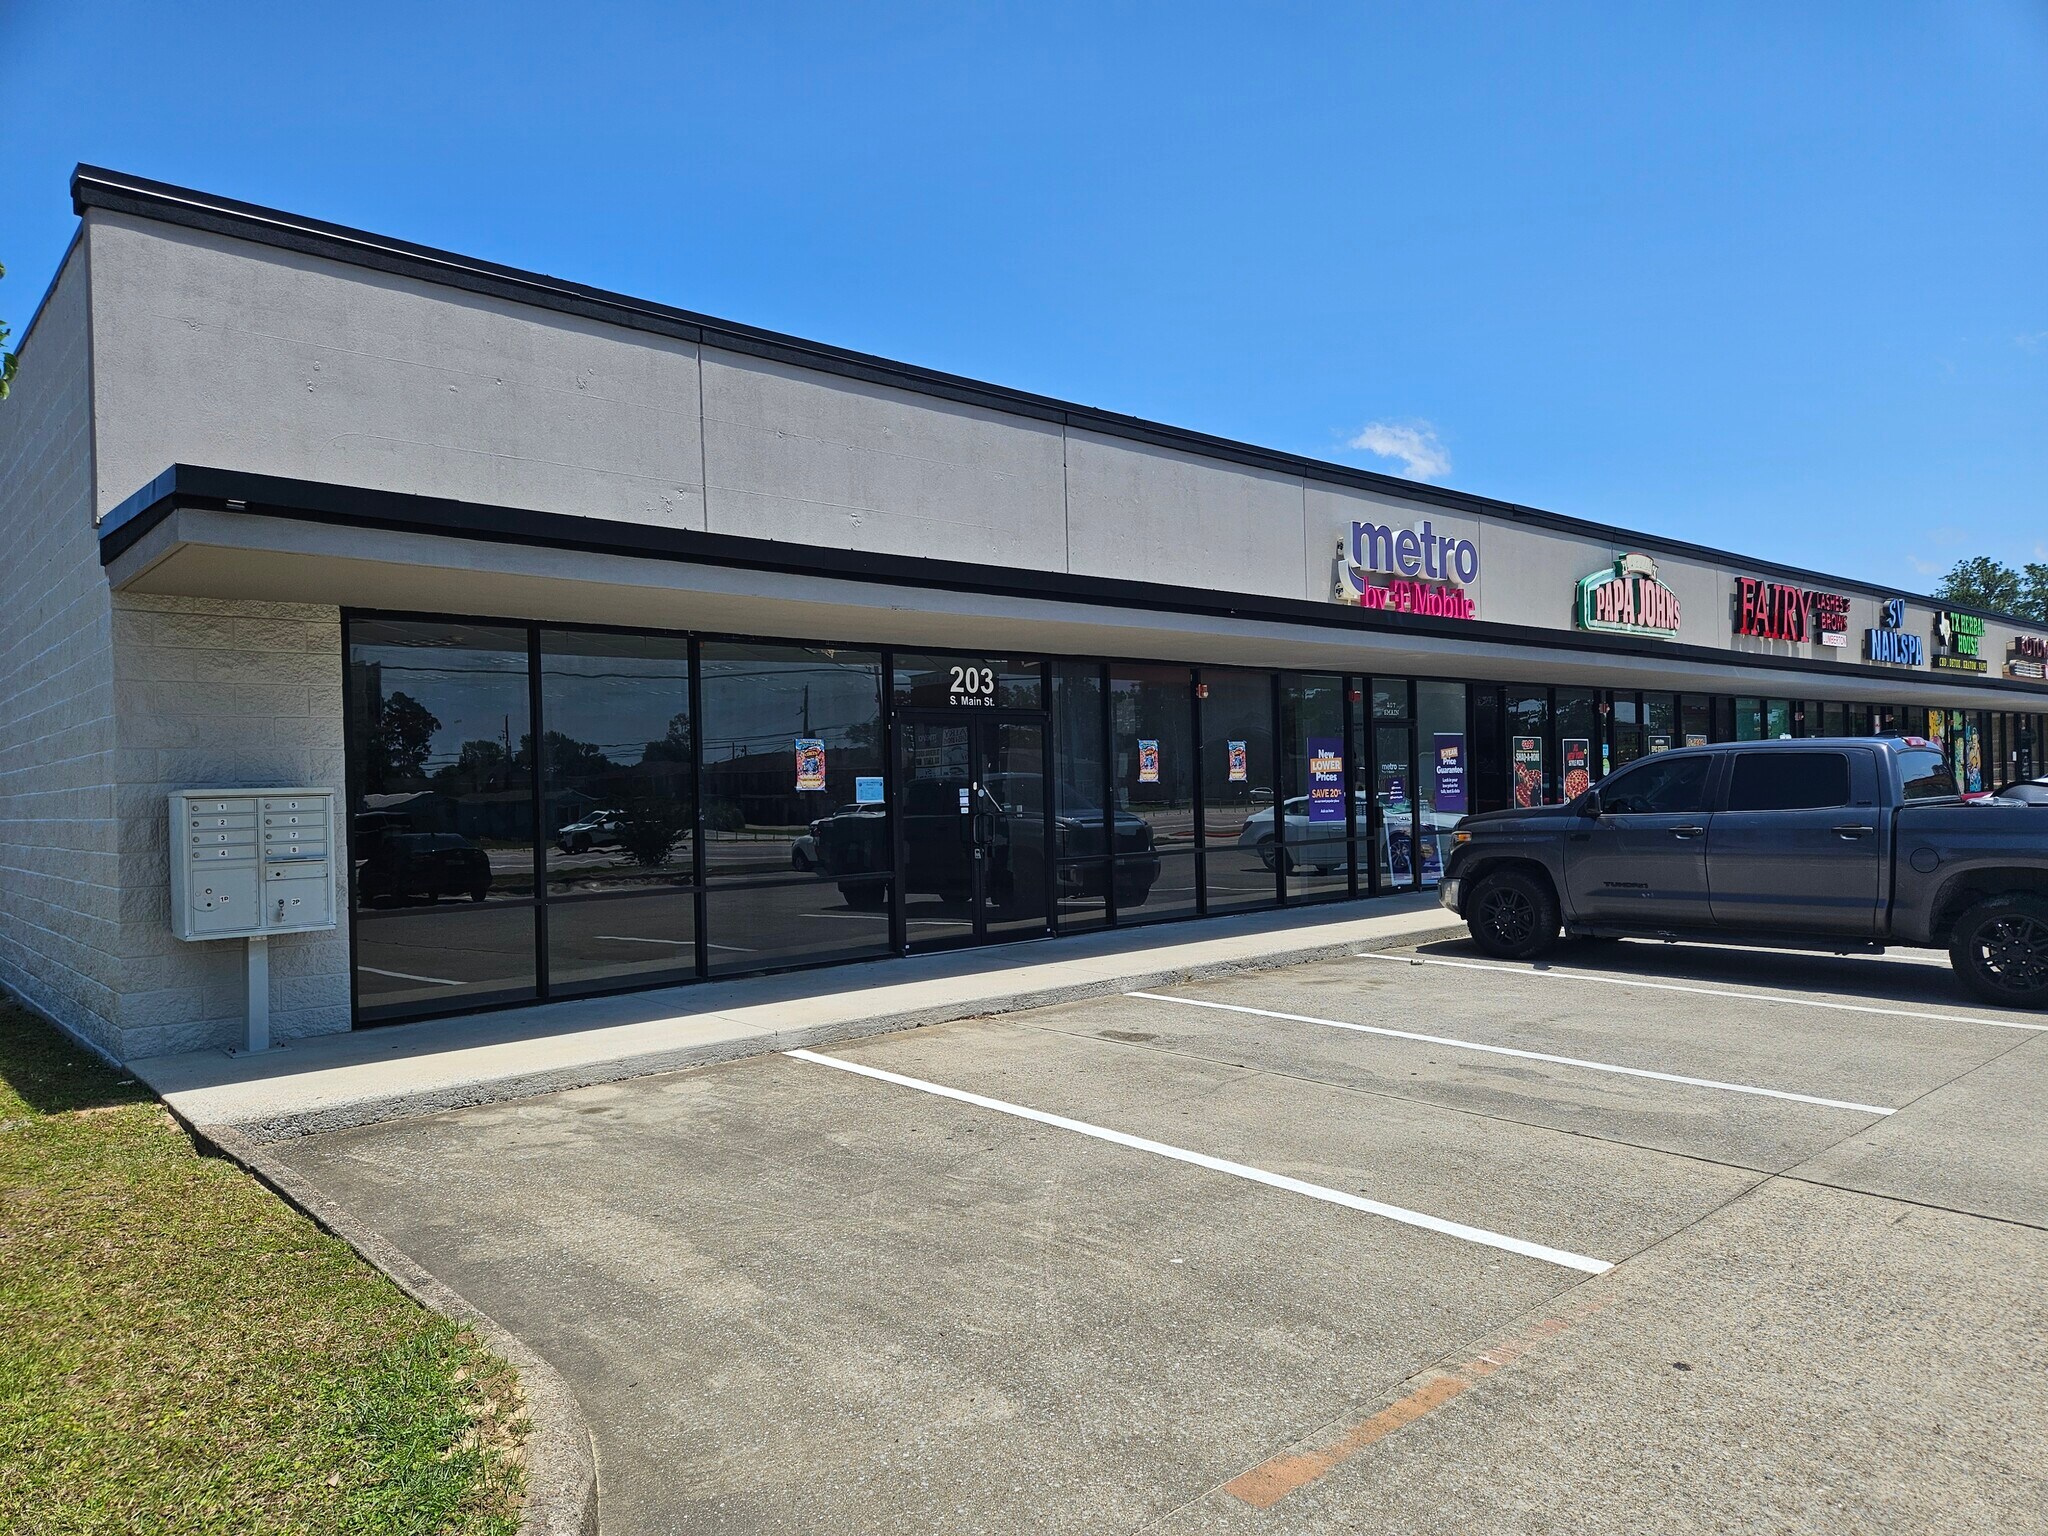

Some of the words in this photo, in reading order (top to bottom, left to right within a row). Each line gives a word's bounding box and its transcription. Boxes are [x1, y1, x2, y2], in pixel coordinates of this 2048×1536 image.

[1350, 520, 1479, 585] metro
[1596, 578, 1635, 624] PAPA
[1638, 579, 1681, 630] JOHNS
[1737, 577, 1813, 643] FAIRY
[1817, 593, 1843, 613] LASHES
[1821, 612, 1848, 632] BROWS
[1961, 615, 1985, 637] HERBAL
[1958, 634, 1979, 656] HOUSE
[950, 666, 994, 694] 203
[949, 695, 958, 705] S.
[961, 696, 982, 706] Main
[983, 697, 995, 706] St.
[1318, 749, 1335, 759] New
[1442, 757, 1457, 765] Price
[1312, 760, 1341, 771] LOWER
[1382, 763, 1397, 771] metro
[1436, 765, 1463, 774] Guarantee
[1315, 771, 1338, 781] Prices
[1311, 789, 1329, 798] SAVE
